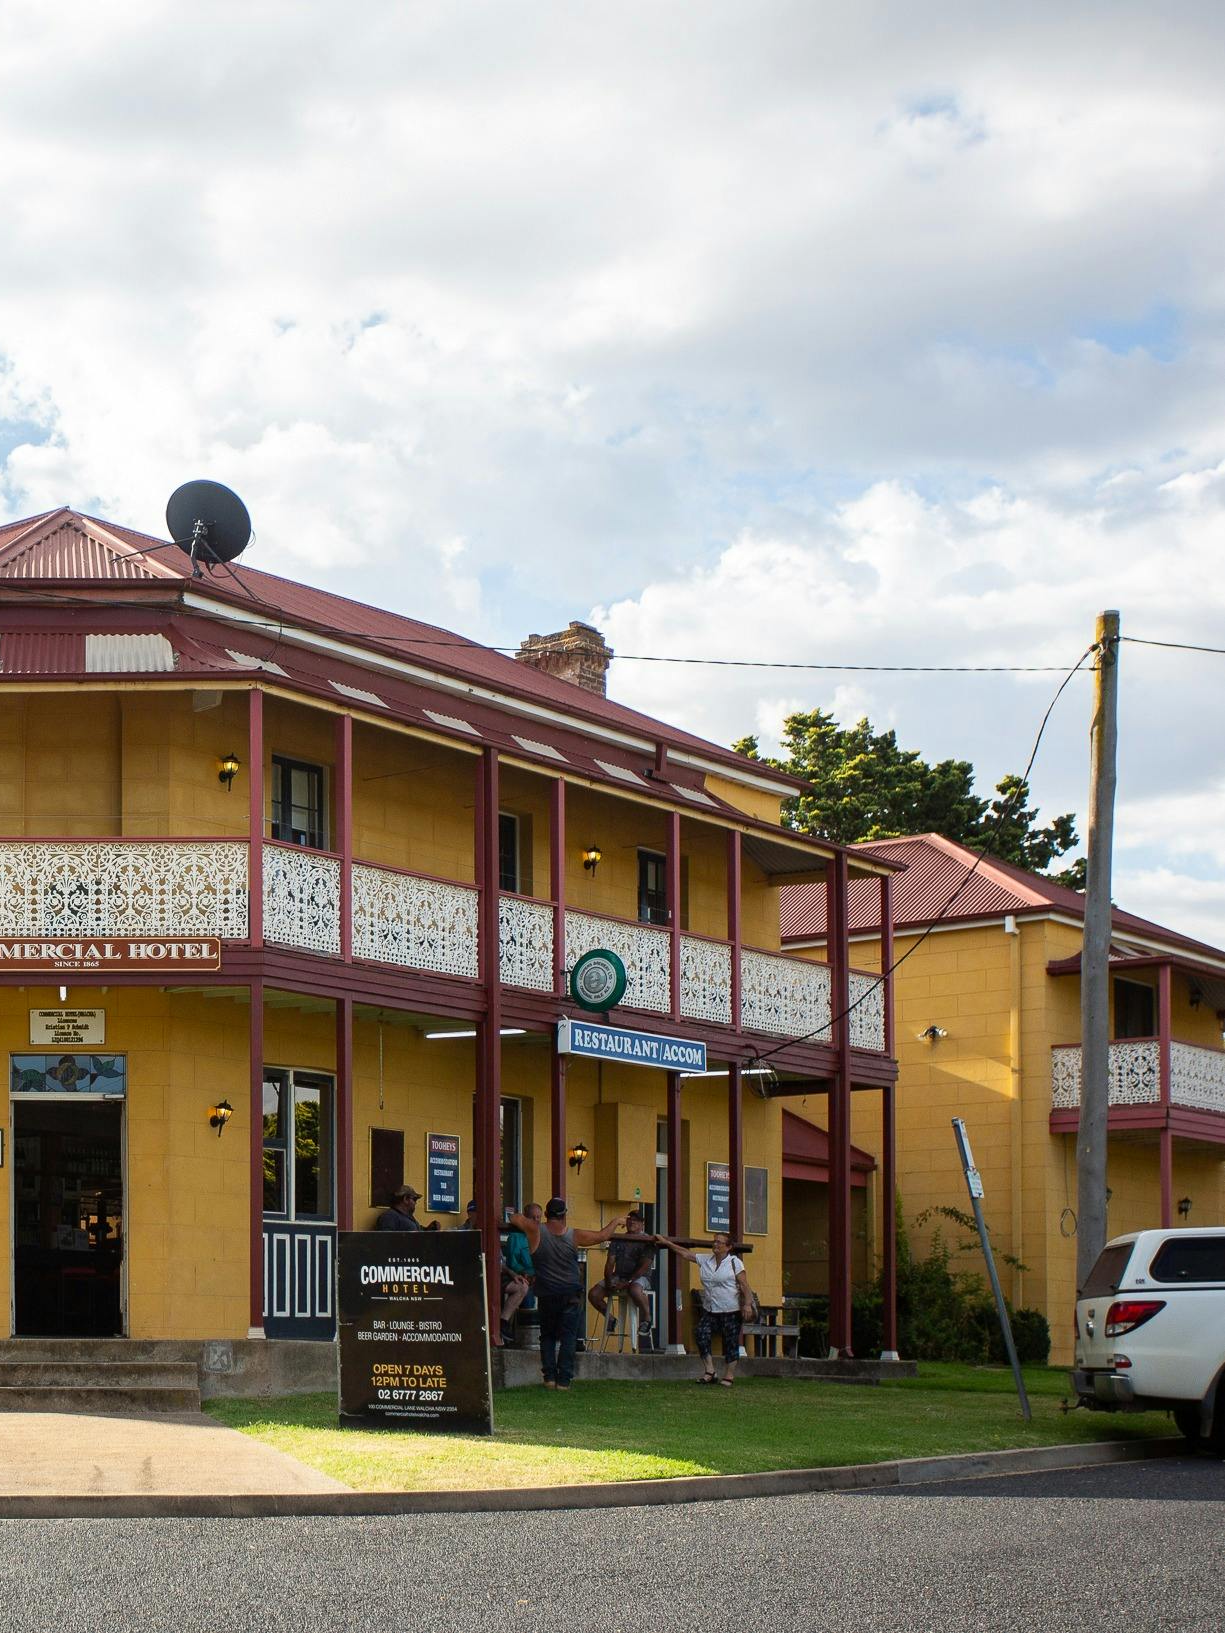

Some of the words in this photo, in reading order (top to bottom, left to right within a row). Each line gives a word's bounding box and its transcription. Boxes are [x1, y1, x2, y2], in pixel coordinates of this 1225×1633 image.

[128, 943, 218, 960] HOTEL
[574, 1028, 702, 1065] RESTAURANT/ACCOM
[431, 1140, 456, 1152] TOOHEYS
[360, 1265, 454, 1286] COMMERCIAL
[382, 1284, 429, 1293] HOTEL
[373, 1320, 386, 1330] BAR
[389, 1321, 414, 1330] LOUNGE
[419, 1321, 442, 1330] BISTRO
[357, 1331, 372, 1340] BEER
[373, 1332, 398, 1341] GARDEN
[402, 1332, 462, 1342] ACCOMMODATION
[373, 1364, 402, 1375] OPEN
[404, 1365, 411, 1375] 7
[413, 1365, 443, 1376] DAYS
[371, 1376, 400, 1387] 12PM
[401, 1377, 416, 1387] TO
[419, 1378, 447, 1388] LATE
[378, 1389, 391, 1400] 02
[392, 1390, 416, 1400] 6777
[419, 1391, 444, 1401] 2667
